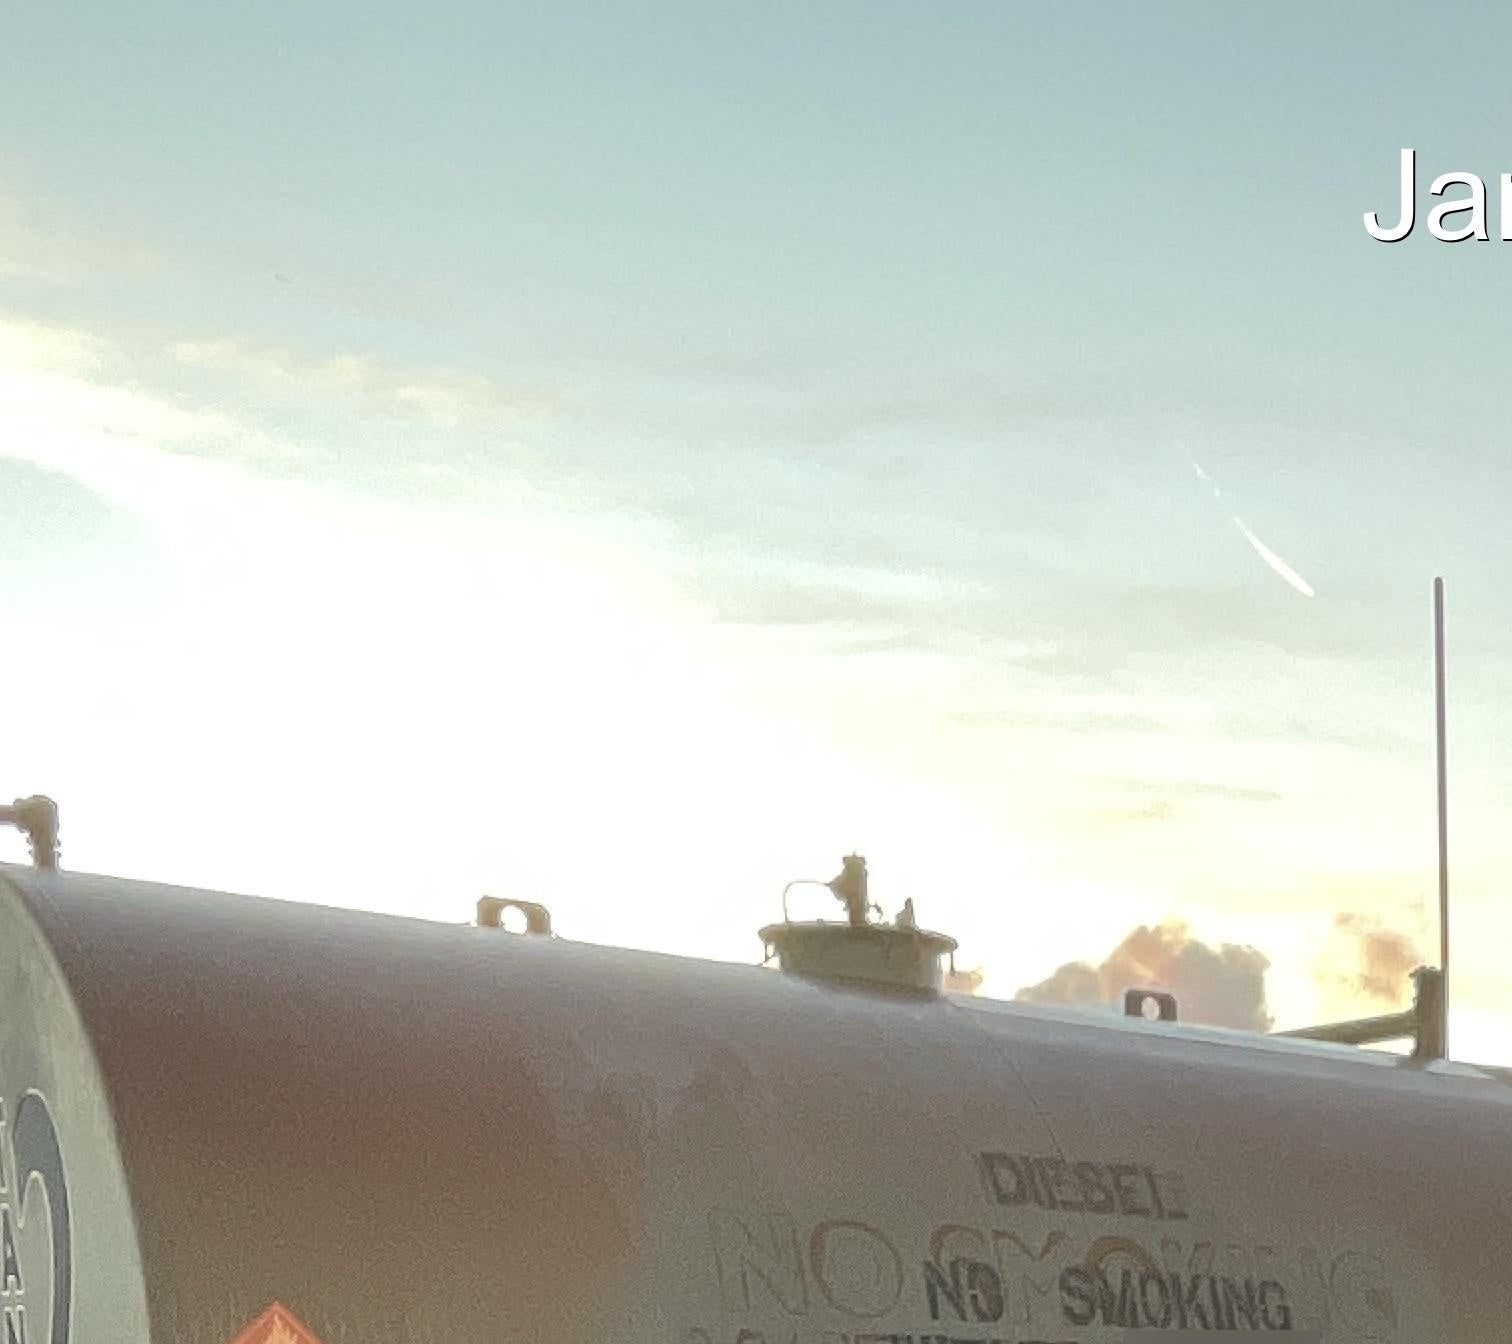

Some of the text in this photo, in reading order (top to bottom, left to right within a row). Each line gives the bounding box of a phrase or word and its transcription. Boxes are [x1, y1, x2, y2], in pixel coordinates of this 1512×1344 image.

[978, 1150, 1189, 1221] DIESEL
[922, 1256, 1295, 1332] NO SMOKING
